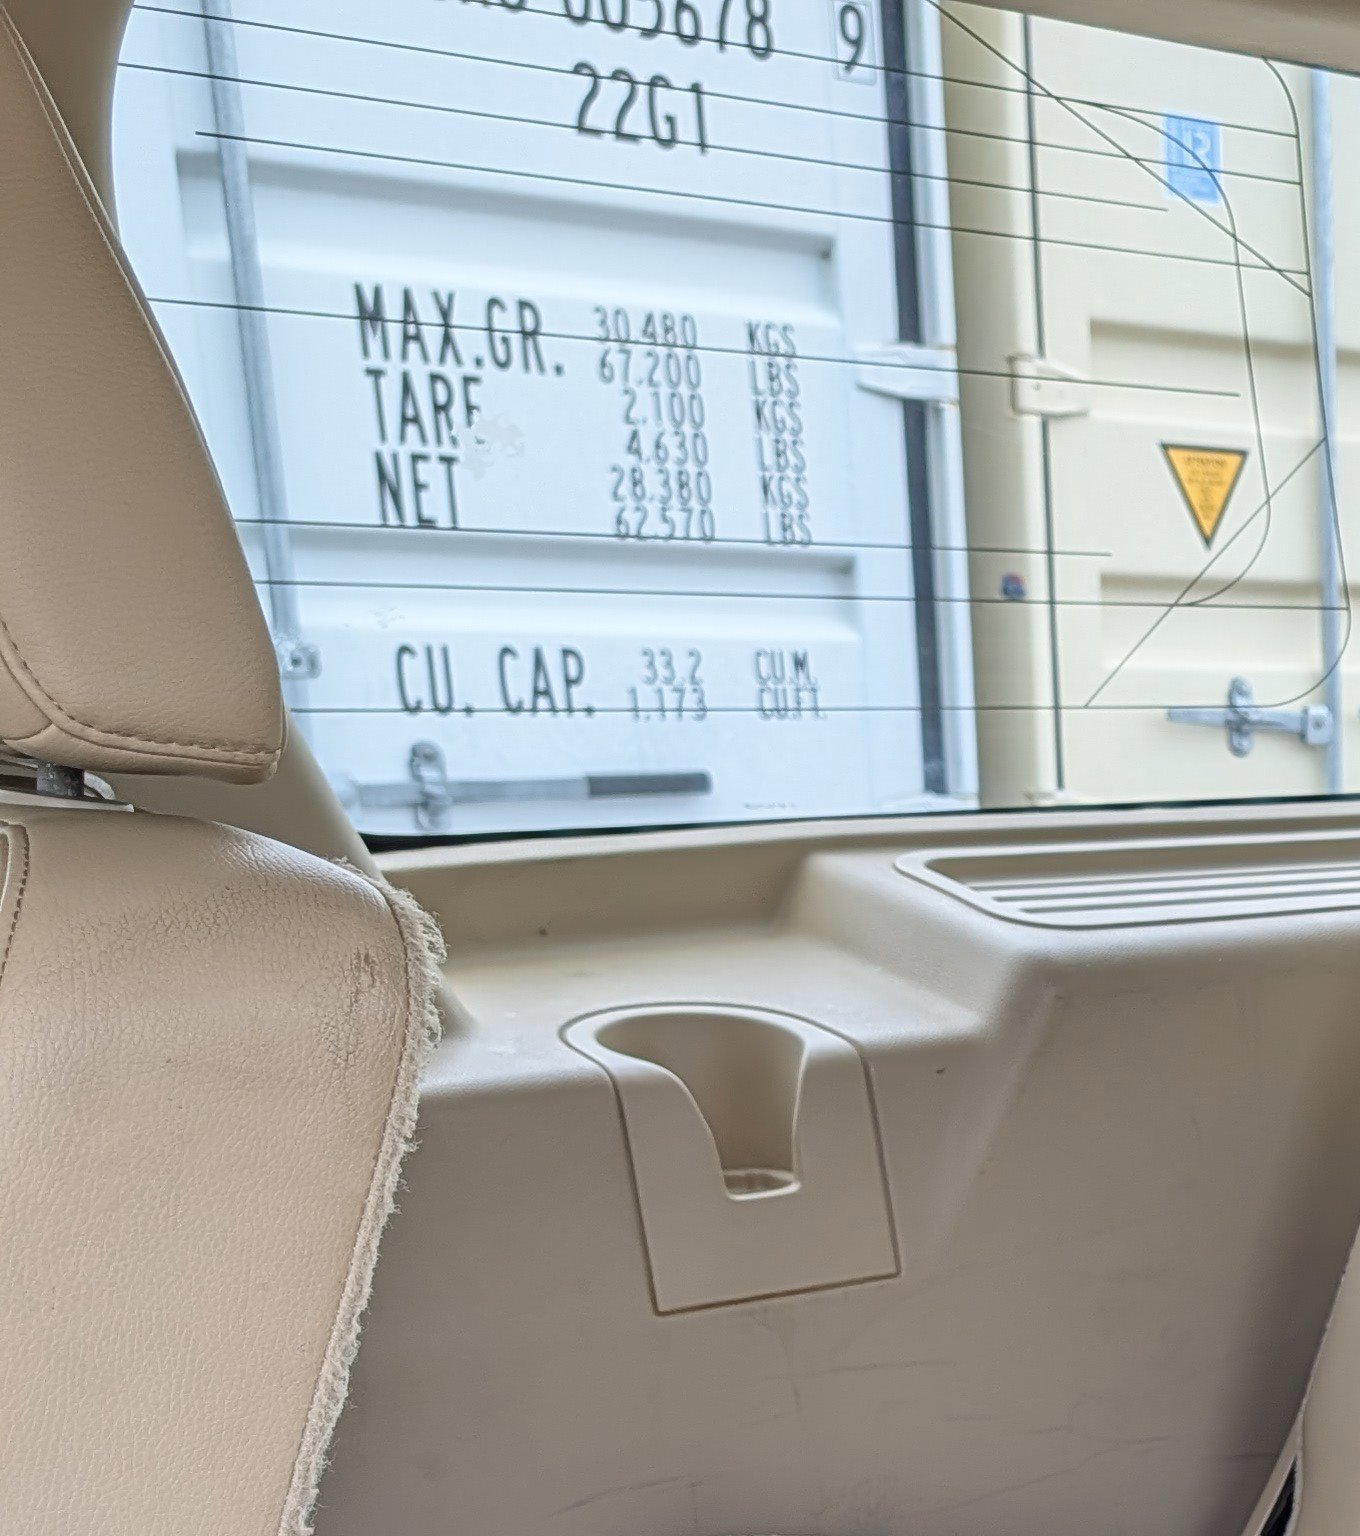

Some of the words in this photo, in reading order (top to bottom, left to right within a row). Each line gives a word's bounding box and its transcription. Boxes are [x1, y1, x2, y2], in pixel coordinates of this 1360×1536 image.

[840, 3, 864, 72] 9
[572, 61, 708, 156] 22G1
[354, 281, 567, 376] MAX.GR.
[746, 319, 799, 358] KGS
[598, 347, 702, 391] 67.200
[750, 357, 801, 399] LBS
[754, 399, 803, 437] KGS
[374, 449, 461, 529] NET
[760, 473, 811, 511] KGS
[757, 436, 808, 474] LBS
[763, 510, 813, 546] LBS
[396, 643, 475, 716] CU.
[498, 644, 598, 716] CAP.
